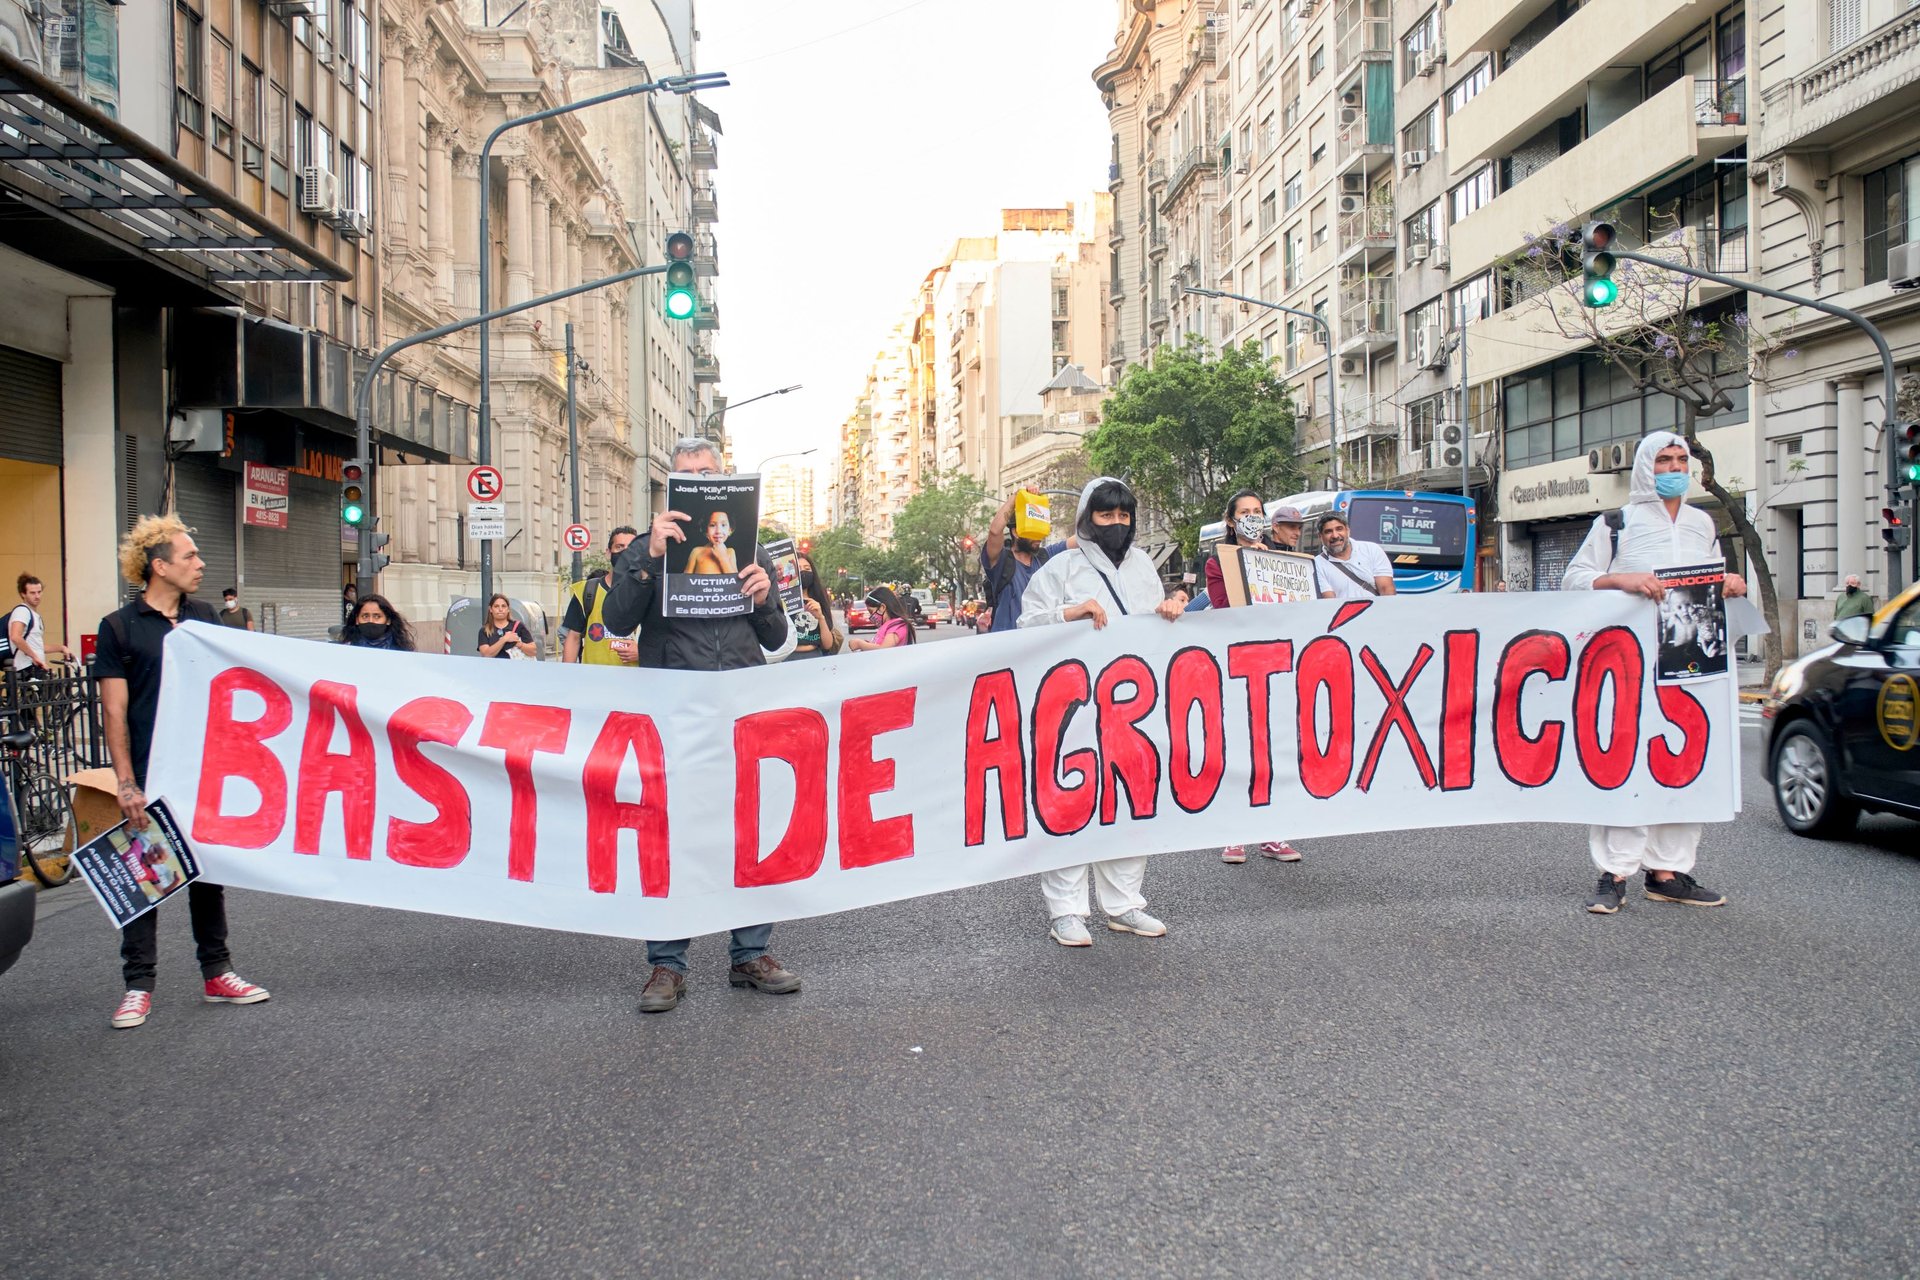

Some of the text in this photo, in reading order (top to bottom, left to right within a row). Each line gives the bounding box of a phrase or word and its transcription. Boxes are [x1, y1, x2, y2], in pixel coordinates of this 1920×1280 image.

[286, 448, 322, 478] LAO
[250, 466, 287, 486] ARANALFE
[675, 485, 699, 493] José
[727, 485, 755, 493] Rivero
[1513, 476, 1590, 504] Casa de Mendoza
[1415, 519, 1437, 530] ART
[1254, 555, 1308, 578] MONOCULTIVO
[1434, 572, 1449, 581] 242
[1655, 569, 1691, 579] Luchemos
[1691, 567, 1713, 575] contra
[689, 578, 737, 586] VICTIMA
[1256, 569, 1269, 583] EL
[1272, 573, 1310, 592] AGRONEGOCIO
[690, 605, 745, 615] GENOCIDIO
[192, 598, 1710, 897] BASTA DE AGROTÓXICOS
[88, 847, 136, 915] AGROTÓXICOS
[110, 853, 137, 893] VICTIMA
[90, 866, 124, 915] GENOCIDIO
